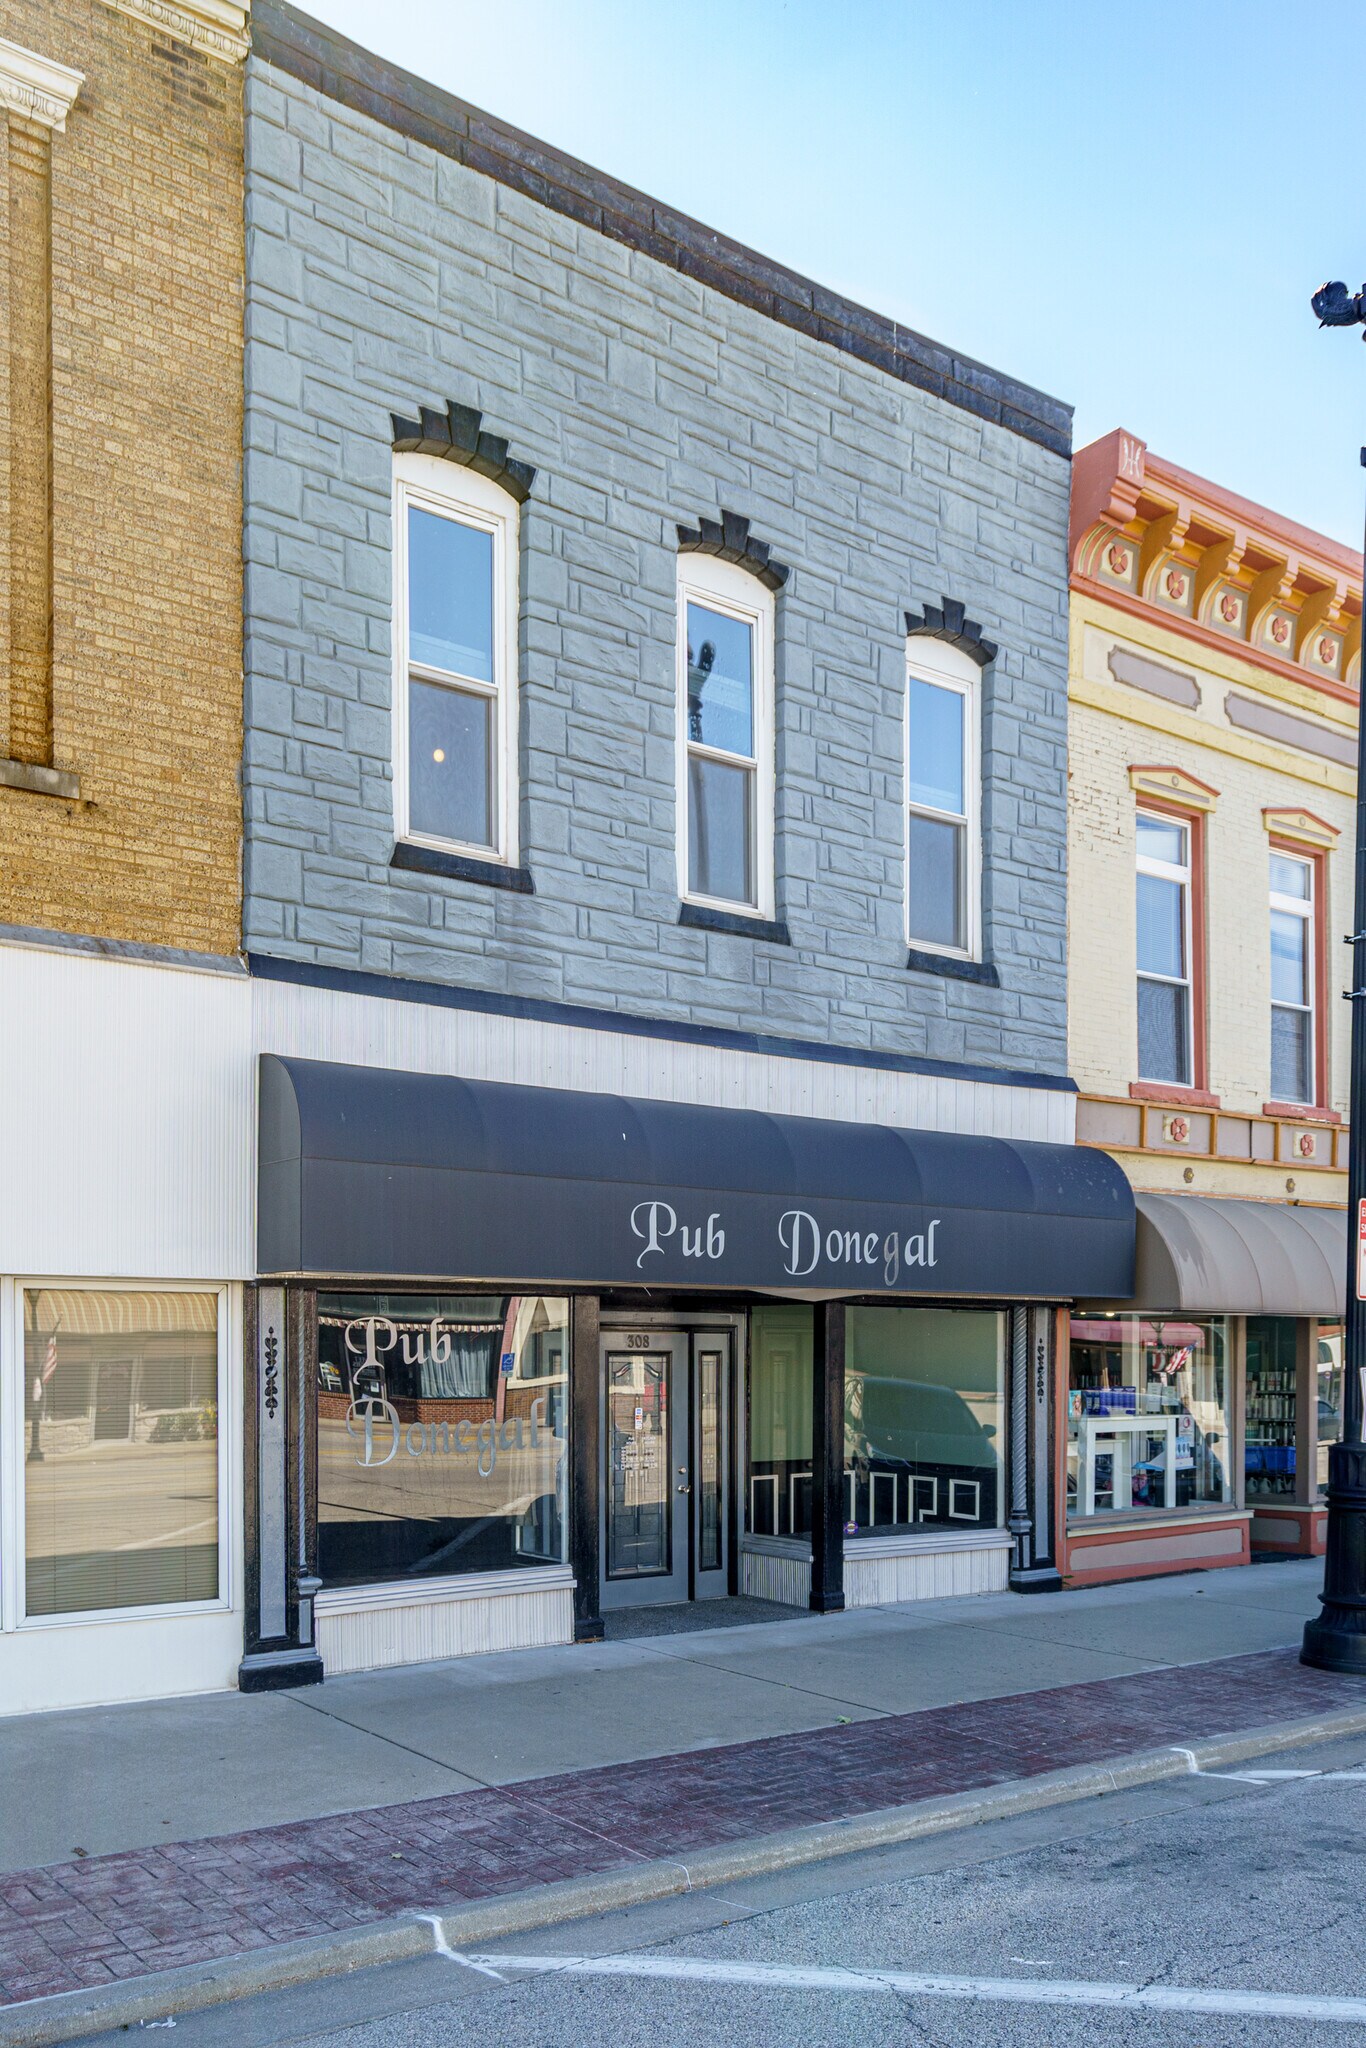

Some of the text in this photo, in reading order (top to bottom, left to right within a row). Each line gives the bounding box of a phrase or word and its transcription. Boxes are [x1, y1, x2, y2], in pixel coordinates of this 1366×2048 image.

[630, 1201, 941, 1287] Pub Donegal
[344, 1316, 451, 1385] Pub
[627, 1334, 650, 1349] 308
[346, 1397, 545, 1478] Donegal
